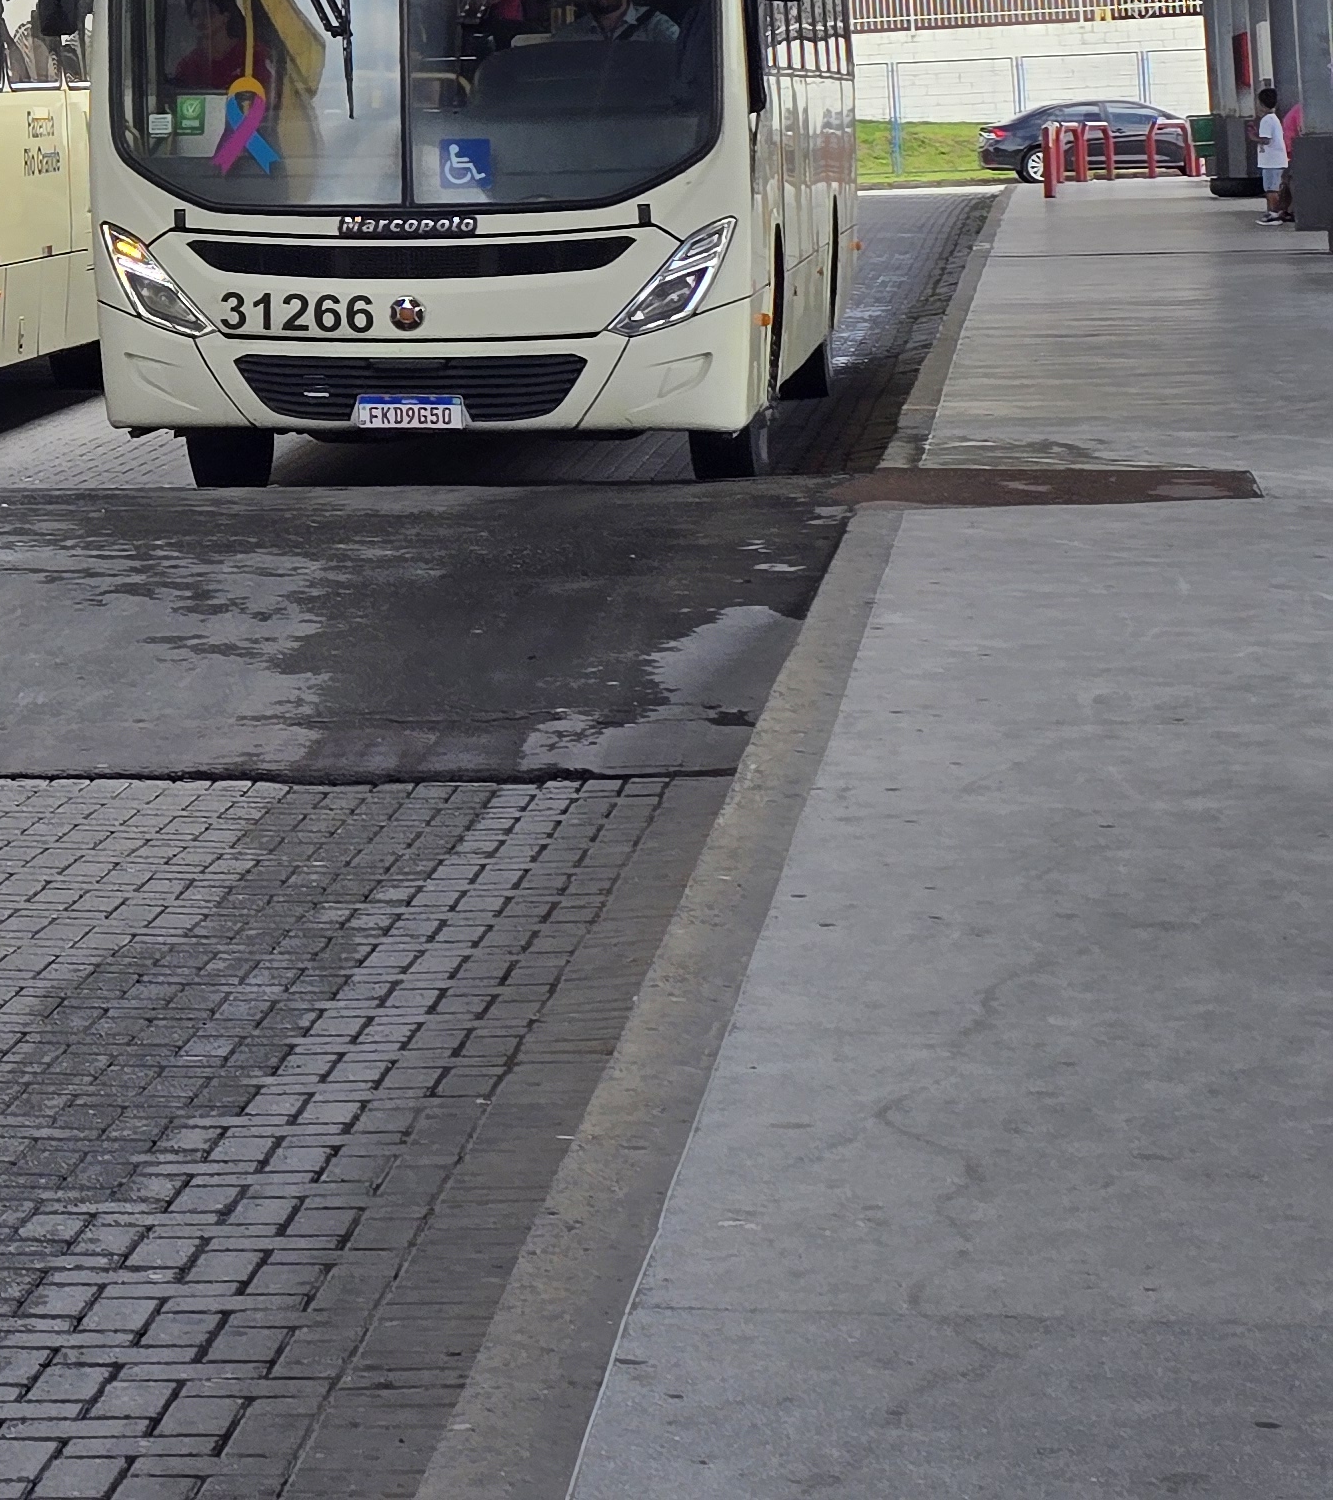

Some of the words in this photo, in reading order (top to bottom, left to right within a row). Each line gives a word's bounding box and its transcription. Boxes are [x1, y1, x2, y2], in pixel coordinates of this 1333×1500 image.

[24, 148, 35, 177] Rio
[37, 145, 60, 175] Grande
[341, 216, 474, 234] Marcopolo
[220, 291, 374, 333] 31266
[368, 406, 453, 425] FKD9G50
